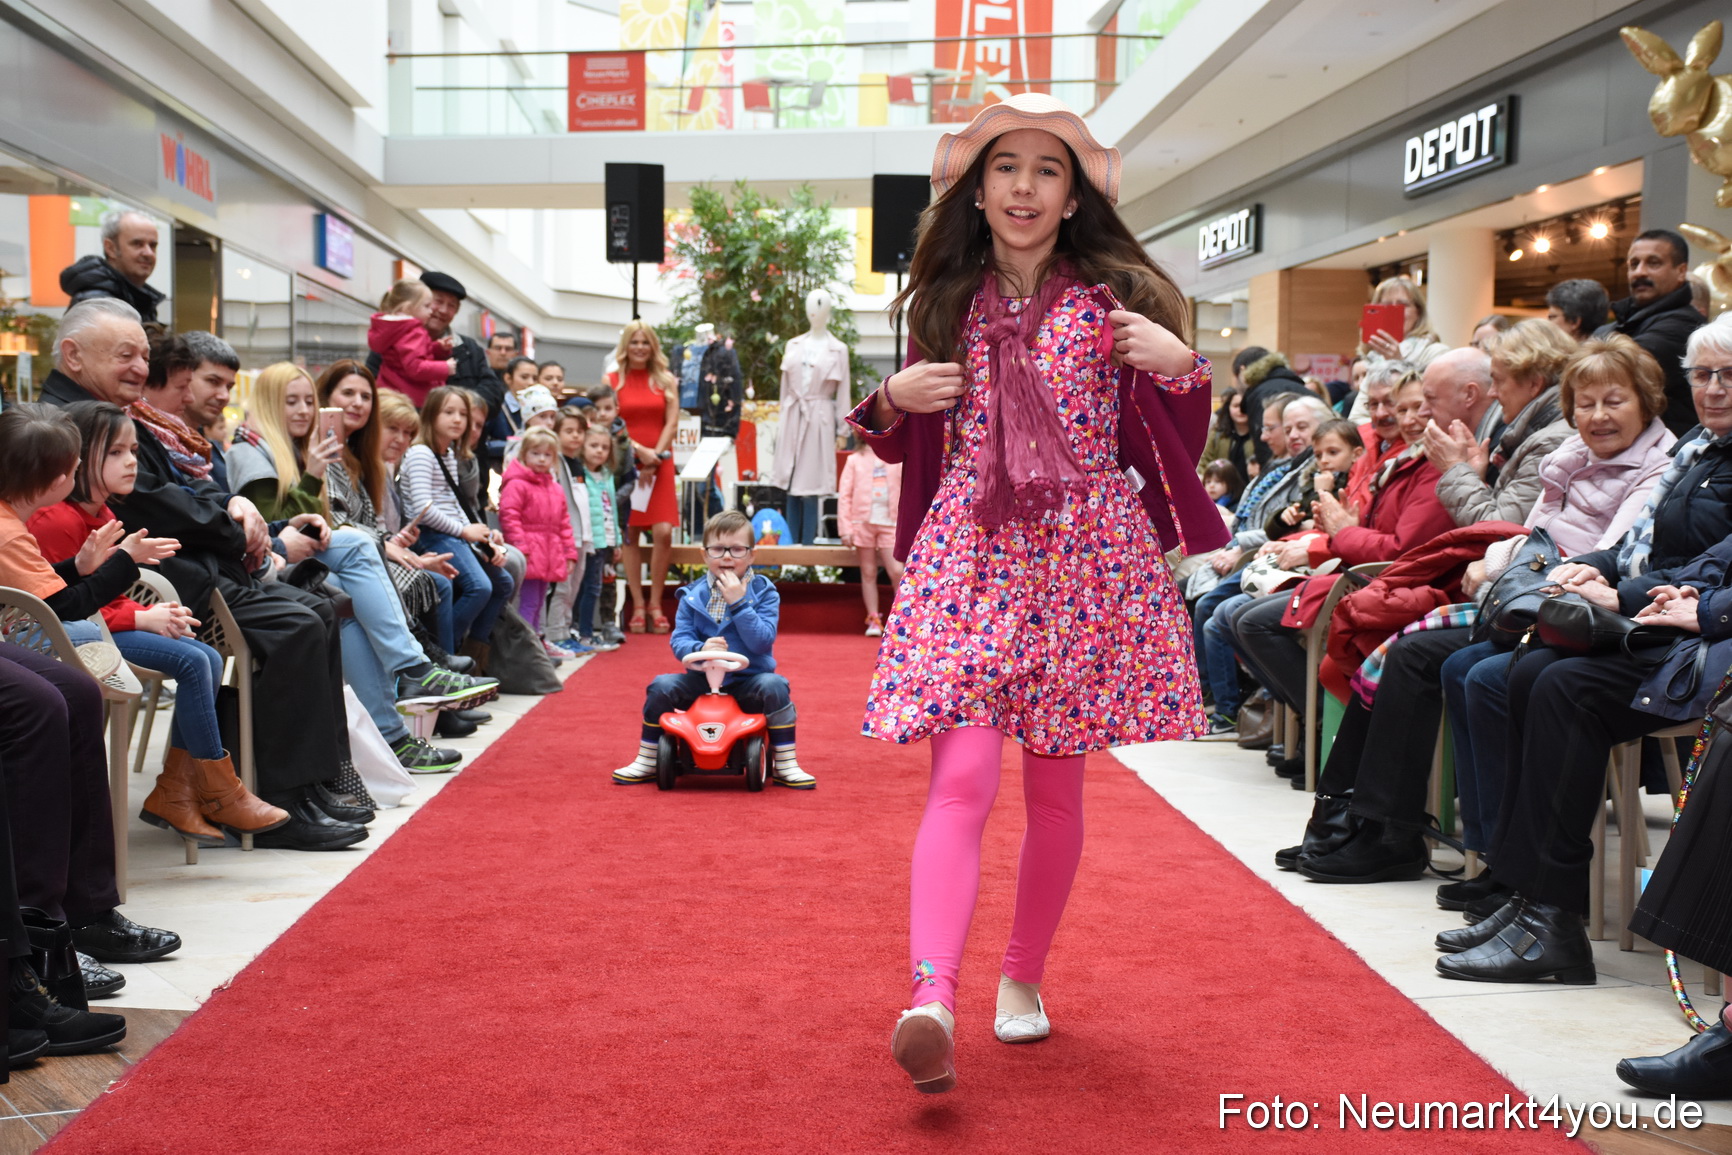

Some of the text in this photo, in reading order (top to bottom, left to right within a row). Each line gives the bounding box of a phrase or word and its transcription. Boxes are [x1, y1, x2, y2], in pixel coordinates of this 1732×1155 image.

[974, 0, 1012, 104] LEX
[1404, 103, 1498, 185] DEPOT
[1199, 208, 1250, 261] DEPOT
[674, 429, 698, 444] EW
